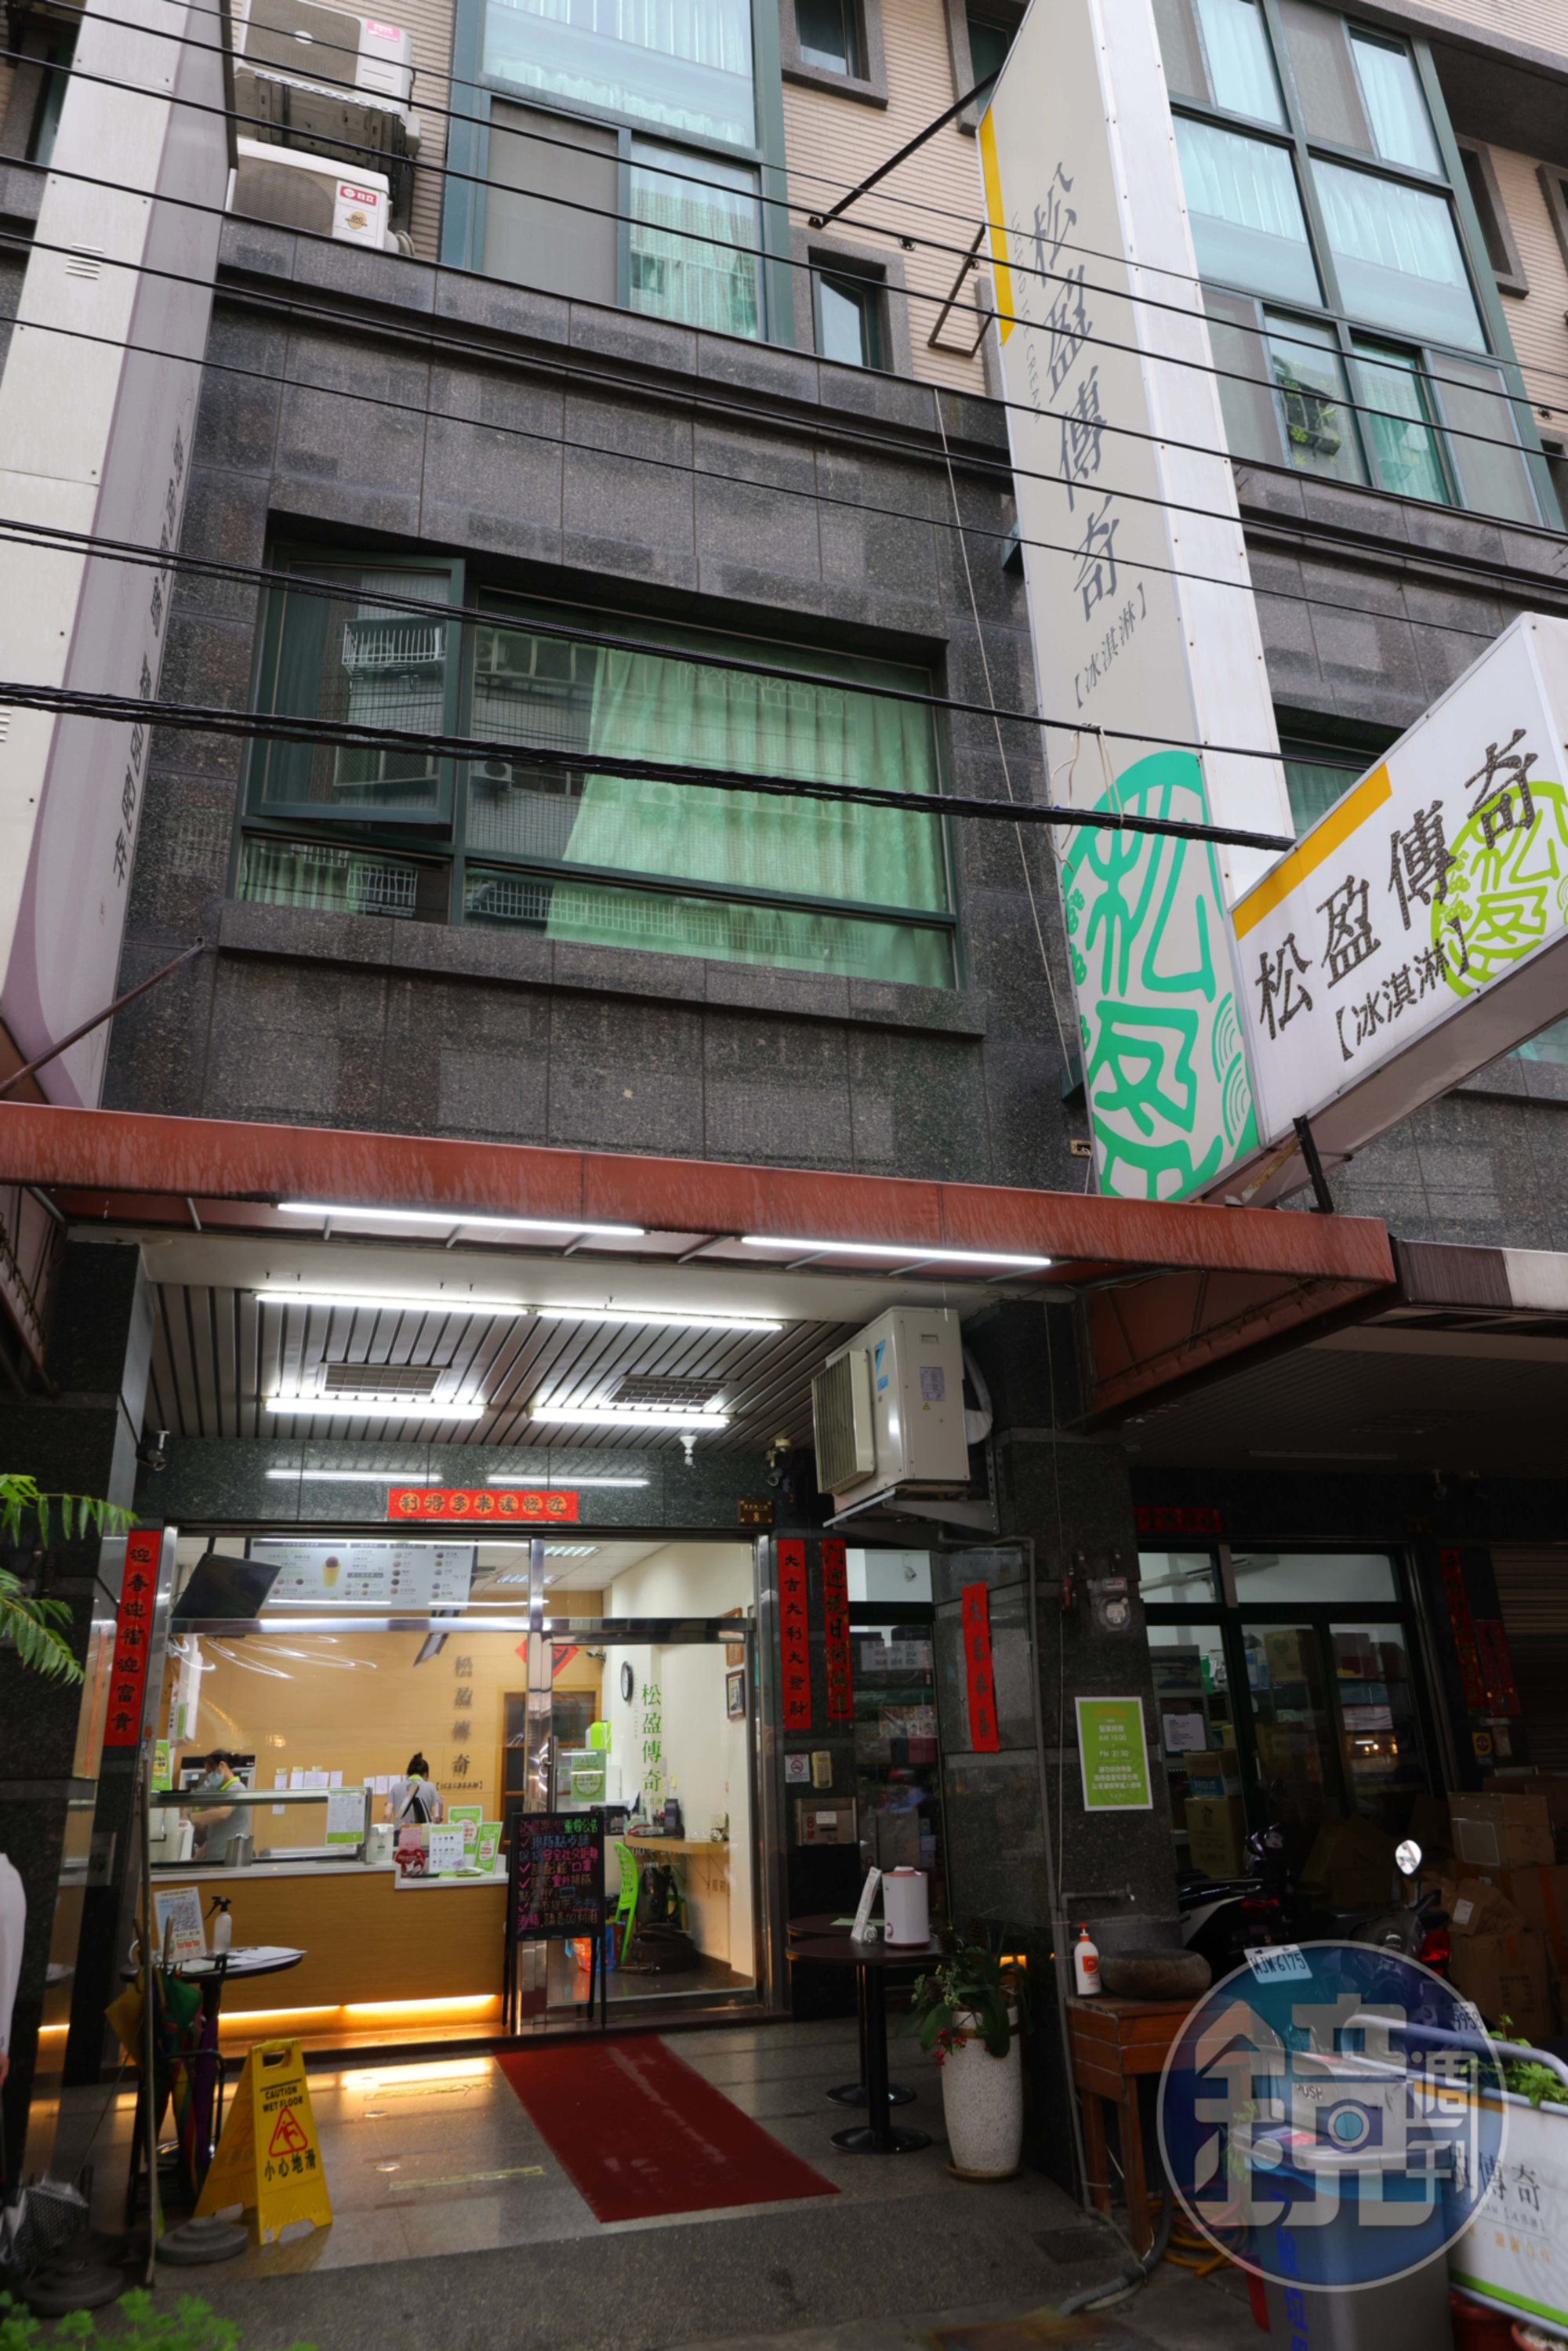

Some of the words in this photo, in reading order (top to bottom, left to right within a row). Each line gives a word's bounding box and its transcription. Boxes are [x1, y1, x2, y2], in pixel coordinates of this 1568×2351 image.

[357, 191, 374, 203] 日立
[1011, 210, 1027, 295] LEGEND
[1022, 298, 1031, 340] ICE
[1026, 343, 1042, 425] CREAM
[1030, 161, 1120, 622] 松盈傳奇
[1254, 728, 1538, 1040] 松盈傳奇
[753, 1511, 760, 1522] 8
[111, 1547, 152, 1732] 迎春迎福迎富貴
[784, 1553, 808, 1717] 大吉大利大發財
[641, 1684, 662, 1792] 松盈傳奇
[1194, 1780, 1216, 1790] TROUT
[807, 1816, 815, 1829] 8
[263, 2101, 279, 2113] WET
[280, 2095, 303, 2109] FLOOR
[265, 2085, 297, 2101] CAUTION
[264, 2149, 316, 2182] 小心地滑
